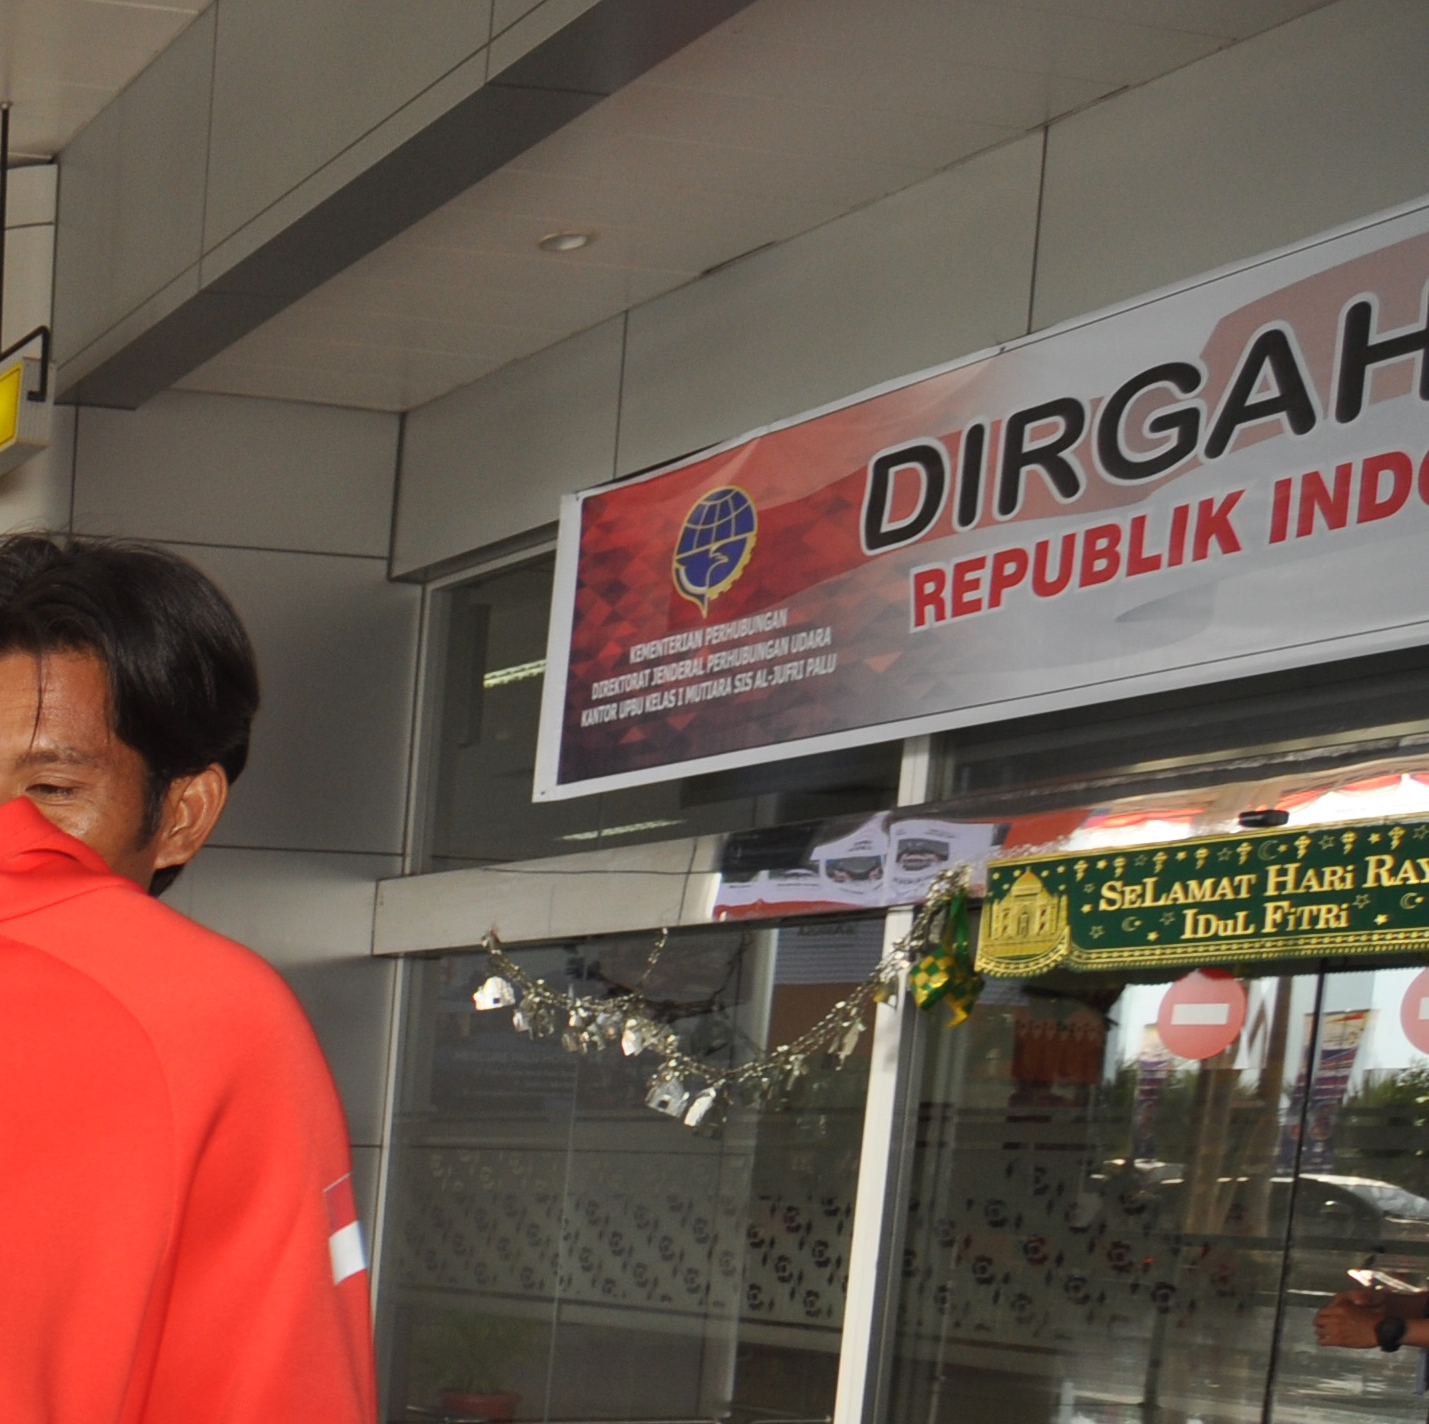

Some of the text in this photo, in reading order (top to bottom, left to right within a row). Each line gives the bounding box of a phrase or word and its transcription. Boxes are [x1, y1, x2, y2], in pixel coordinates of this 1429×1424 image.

[912, 450, 1429, 629] REPUBLIK IND
[591, 626, 832, 700] DIREKTORAT JENDERAL PERHUBUNGAN UDARA
[628, 607, 789, 664] KEMENTERIAN PERHUBUNGAN
[580, 702, 618, 728] KANTOR
[645, 689, 678, 713] KELAS
[684, 677, 733, 704] MUTIARA
[733, 671, 754, 694] SIS
[805, 653, 838, 678] PALU
